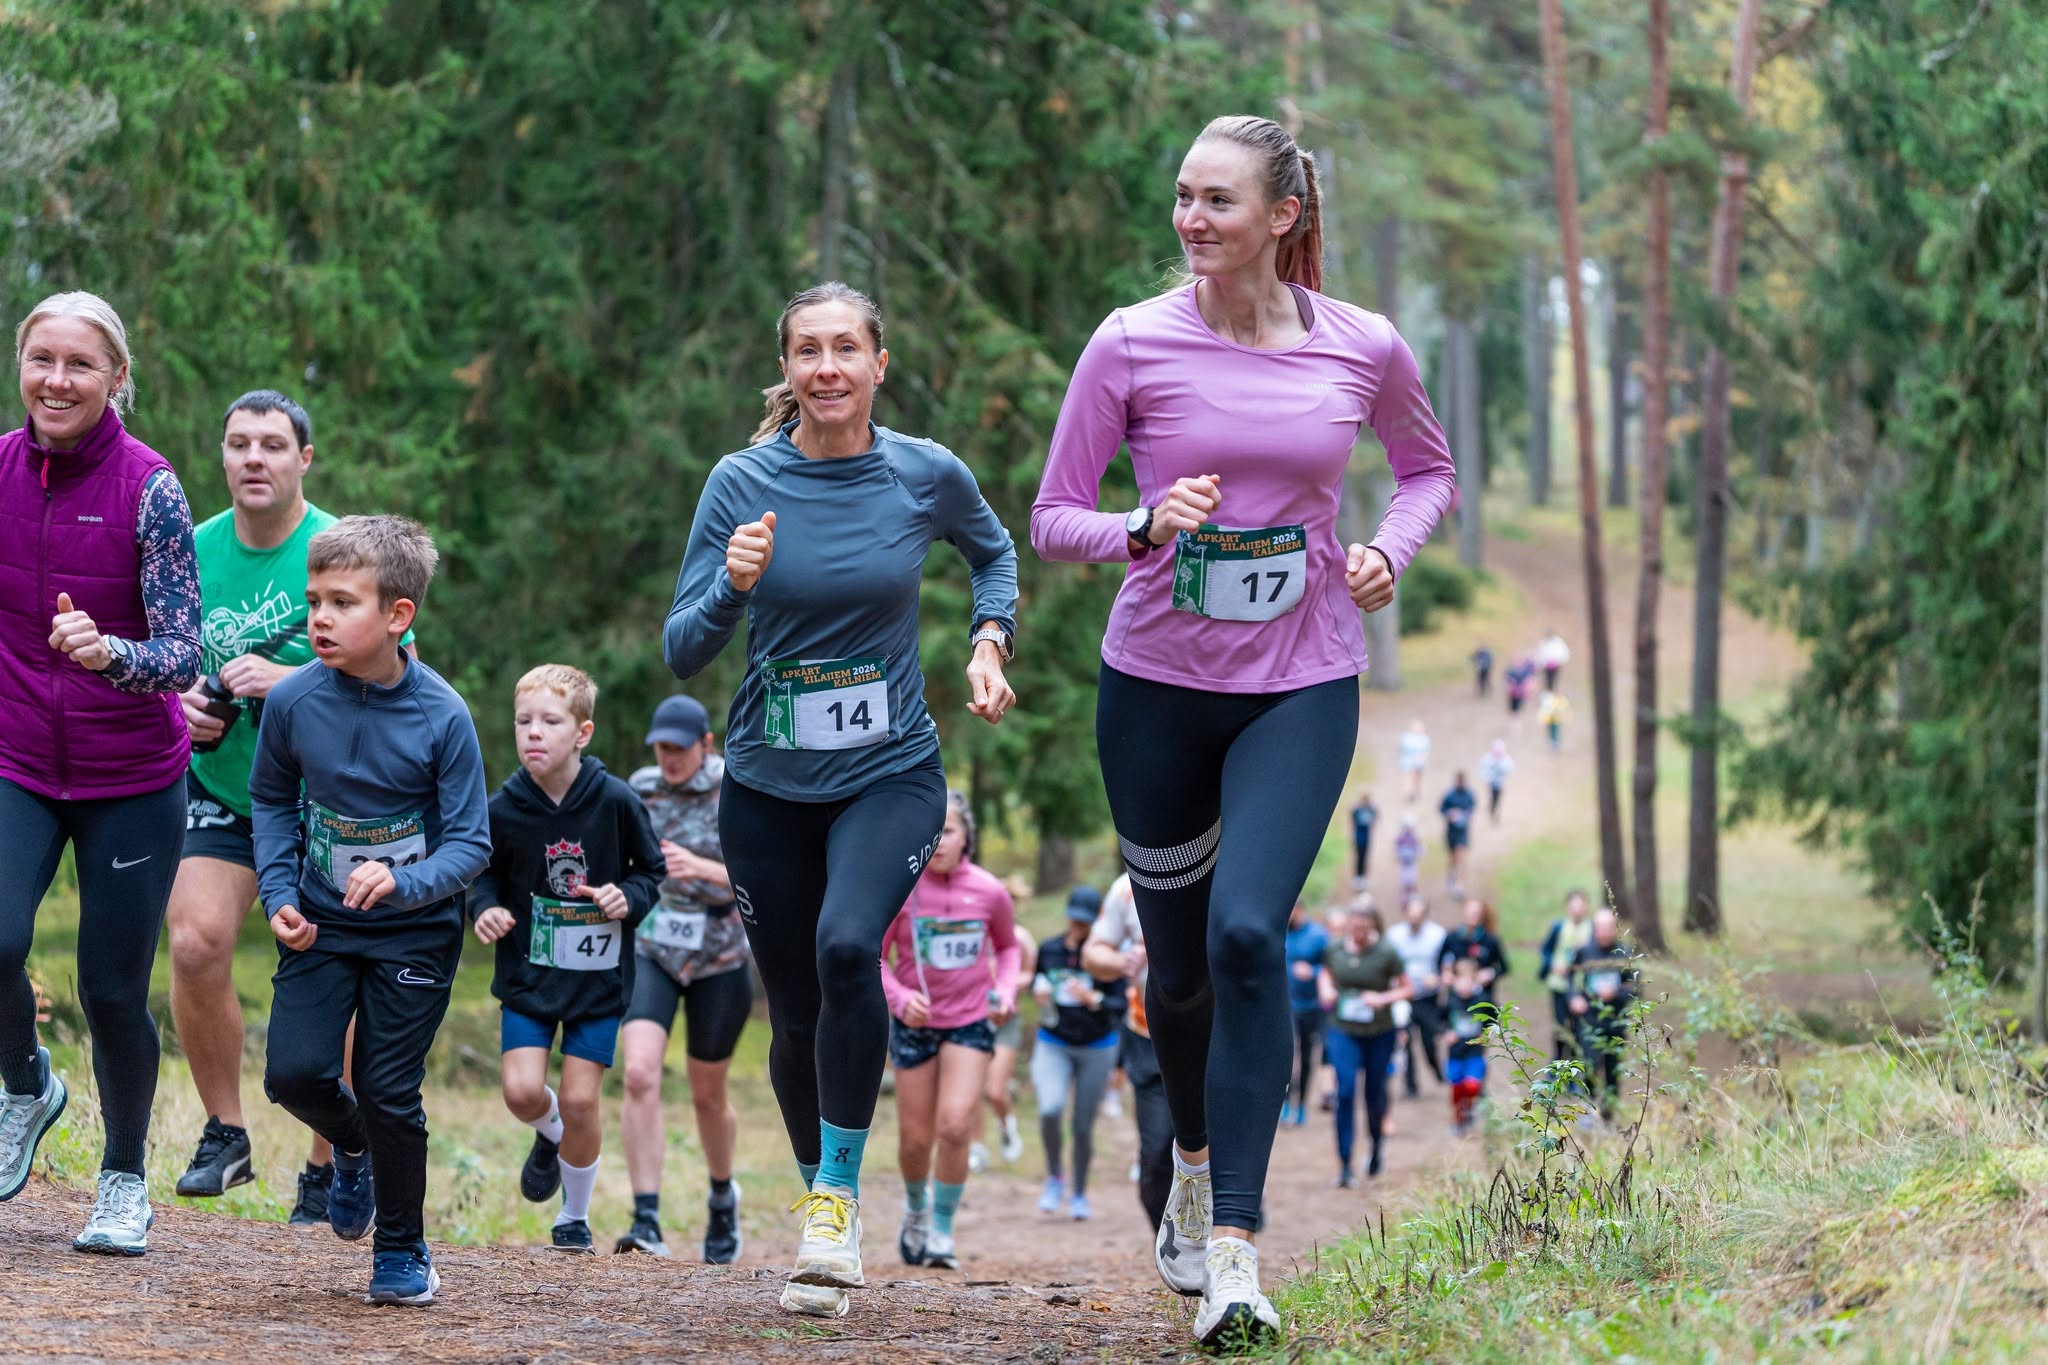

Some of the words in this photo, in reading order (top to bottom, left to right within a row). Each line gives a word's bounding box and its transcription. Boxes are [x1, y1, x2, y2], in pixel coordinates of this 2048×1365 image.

[1197, 532, 1241, 543] APKĀRT
[1220, 538, 1271, 552] ZILAJIEM
[1272, 532, 1297, 545] 2026
[1252, 540, 1302, 558] KALNIEM
[1241, 571, 1289, 603] 17
[781, 666, 821, 679] APKĀRT
[803, 669, 851, 685] ZILAJIEM
[852, 664, 876, 675] 2026
[833, 671, 881, 688] KALNIEM
[826, 700, 873, 732] 14
[341, 826, 389, 839] ZILAJIEM
[370, 825, 418, 845] KALNIEM
[669, 919, 694, 938] 96
[576, 933, 613, 957] 47
[943, 941, 979, 959] 184
